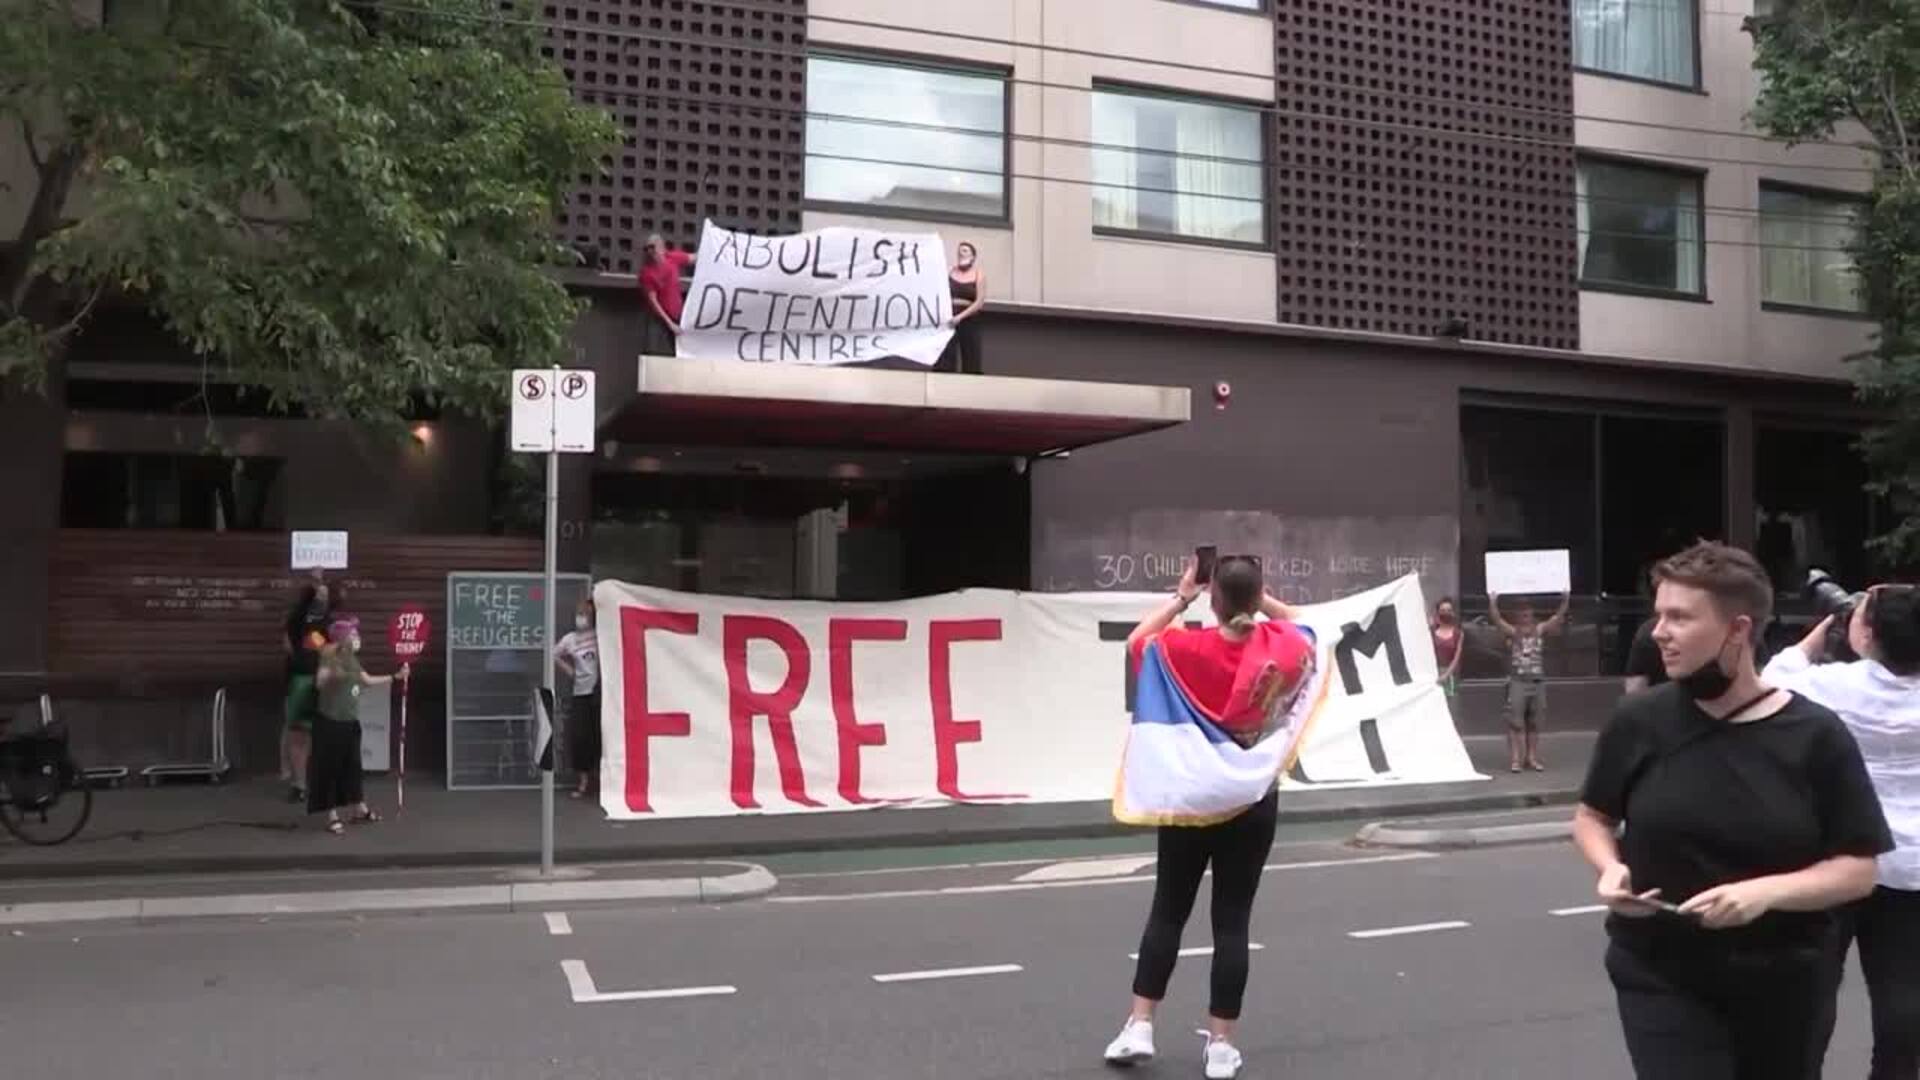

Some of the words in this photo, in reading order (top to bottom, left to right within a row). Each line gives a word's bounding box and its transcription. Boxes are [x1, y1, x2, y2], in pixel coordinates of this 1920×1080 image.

[714, 232, 921, 280] ABOLISH
[1094, 555, 1135, 588] 30
[455, 582, 524, 611] FREE
[397, 611, 424, 629] STOP
[482, 609, 517, 625] THE
[451, 625, 545, 647] REFUGEES
[619, 606, 1031, 814] FREE
